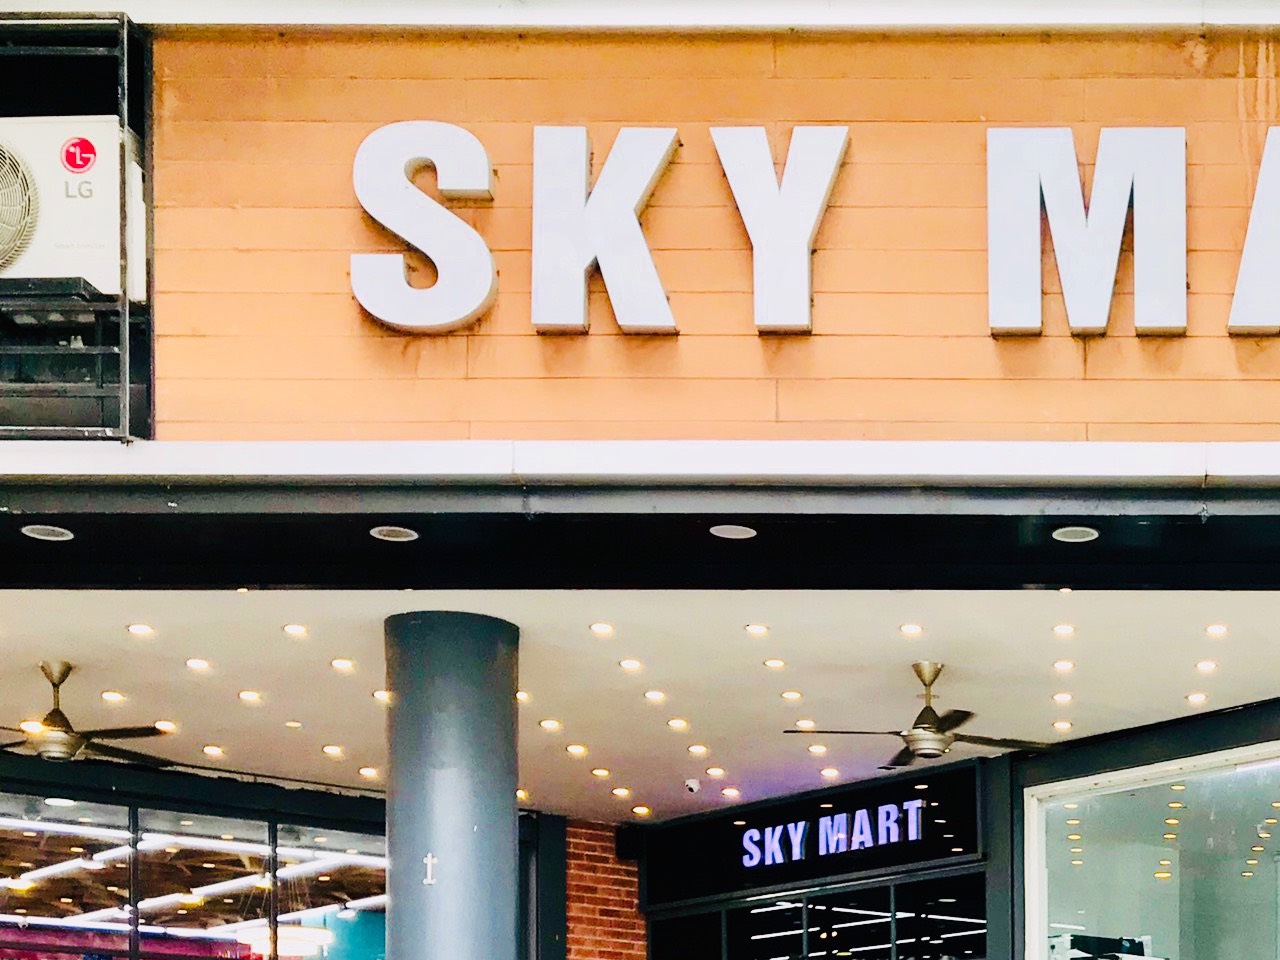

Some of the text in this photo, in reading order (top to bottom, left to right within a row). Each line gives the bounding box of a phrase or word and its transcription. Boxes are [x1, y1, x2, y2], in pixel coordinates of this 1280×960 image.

[64, 181, 94, 199] LG
[351, 121, 850, 334] SKY
[742, 799, 926, 868] SKY MART
